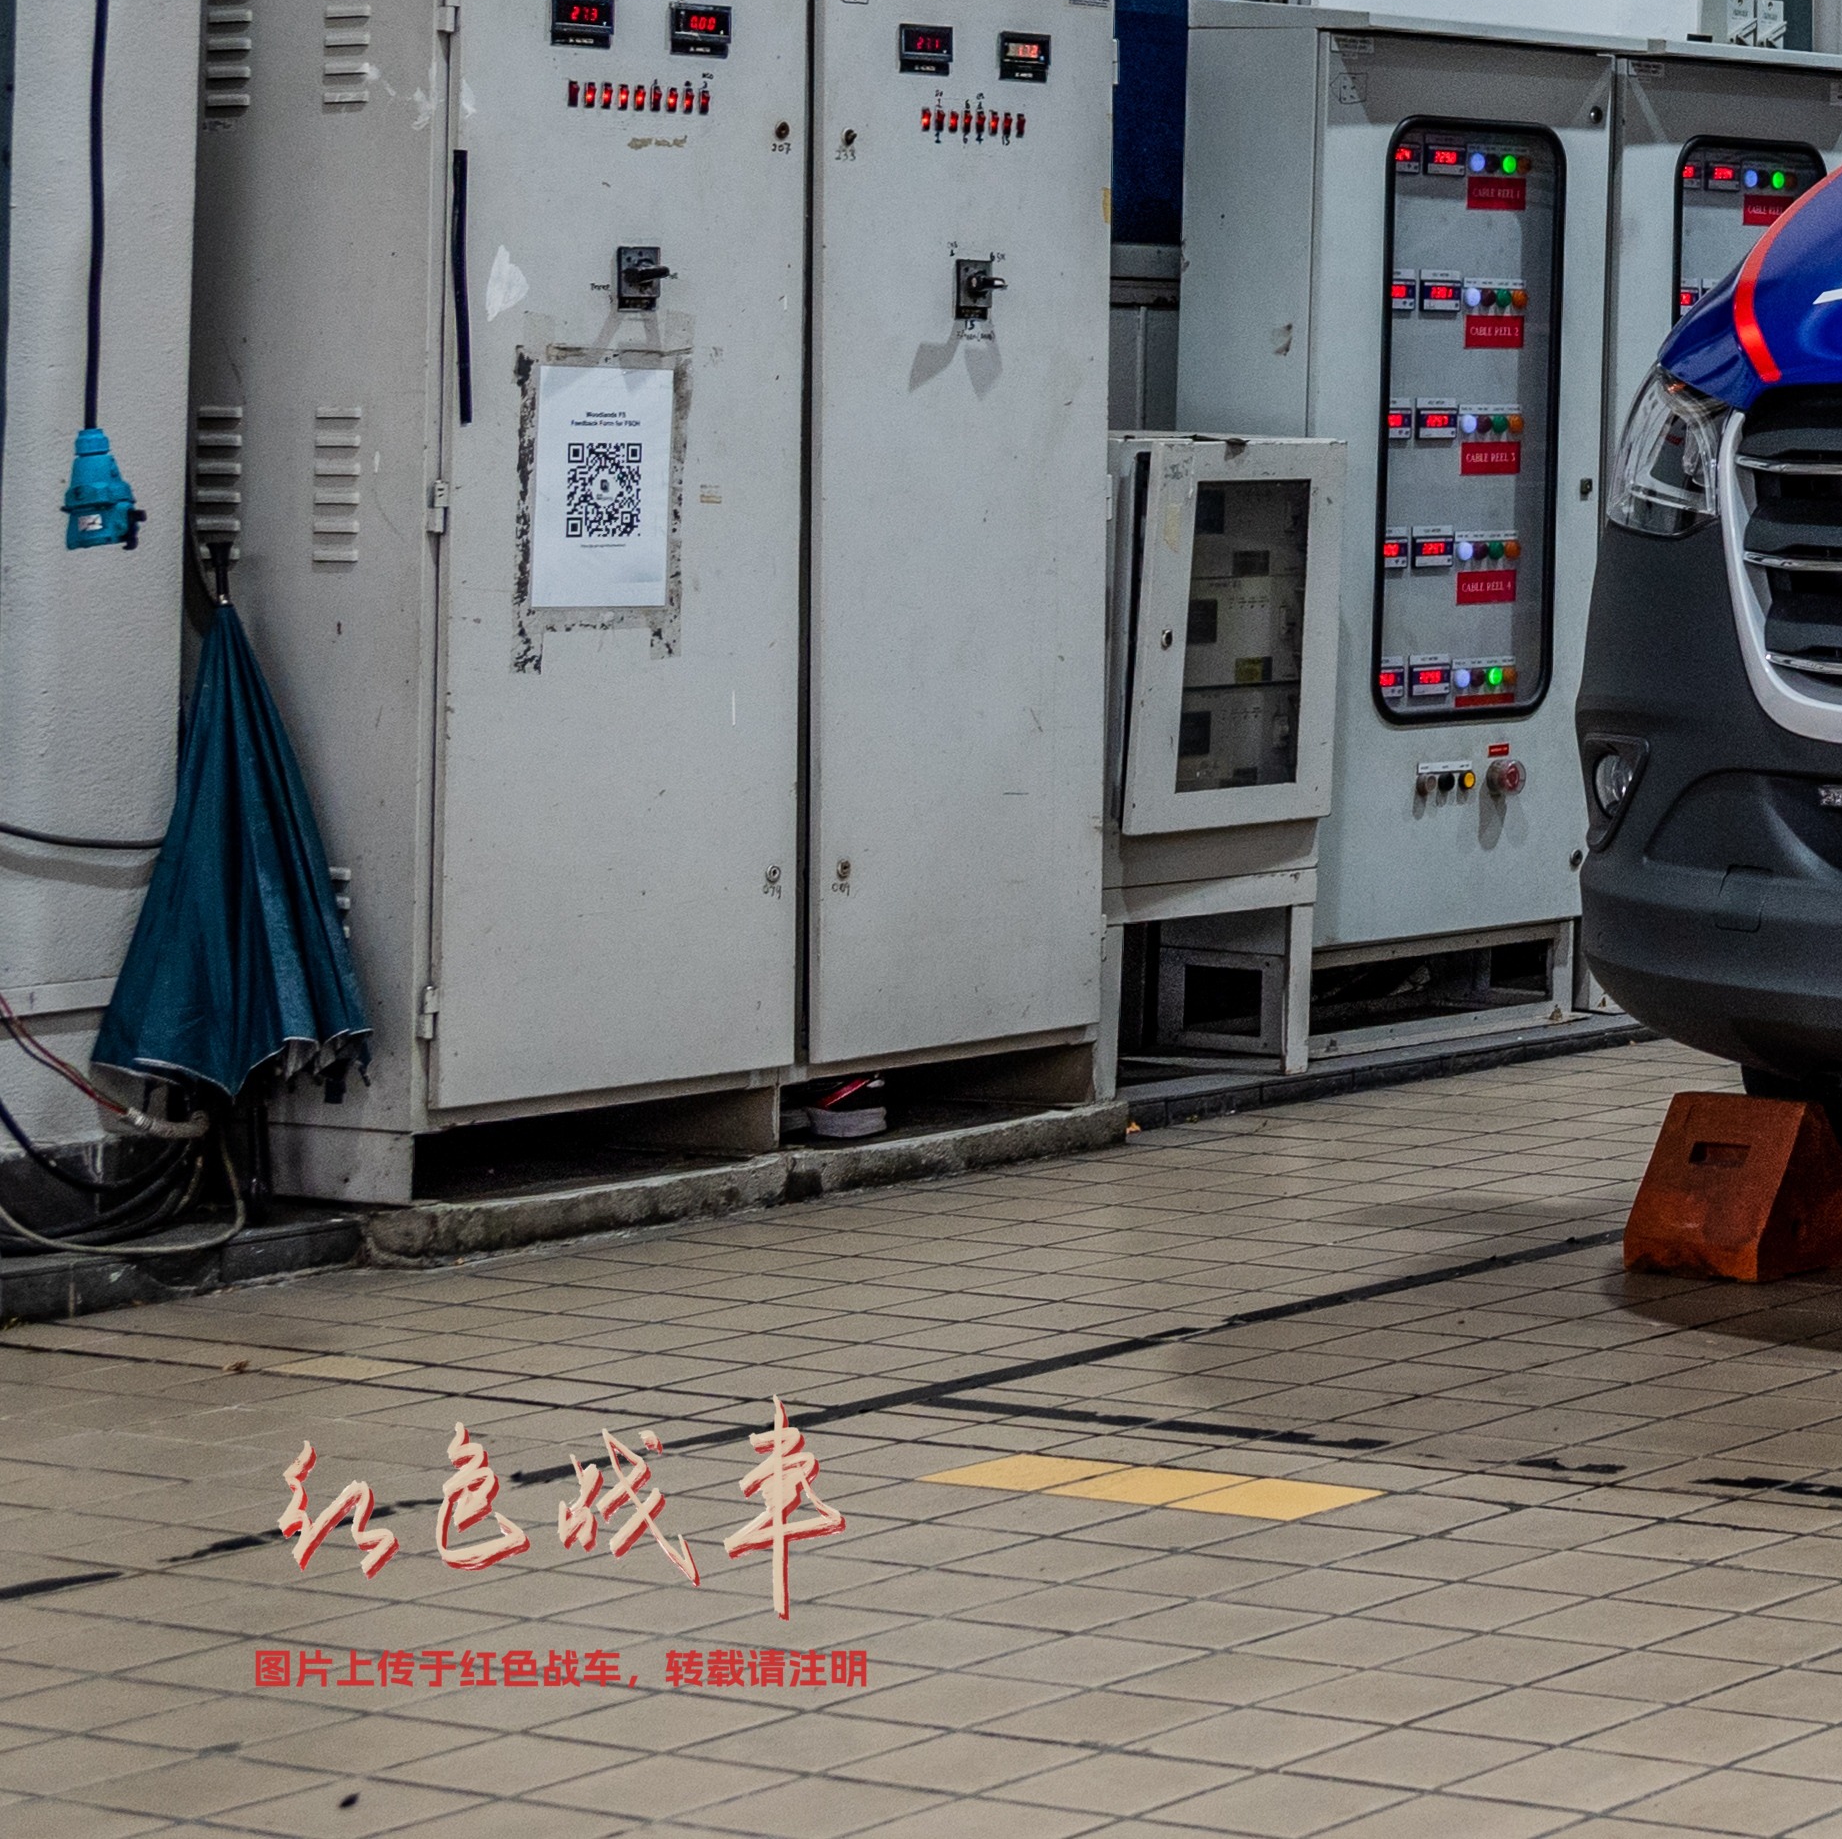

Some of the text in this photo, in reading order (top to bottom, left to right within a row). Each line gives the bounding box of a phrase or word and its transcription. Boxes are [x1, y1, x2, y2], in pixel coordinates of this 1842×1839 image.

[1470, 326, 1492, 336] CABLE
[1494, 326, 1512, 336] REEL
[1466, 452, 1488, 462] CABLE
[1490, 452, 1509, 462] REEL
[1461, 582, 1484, 592] CABLE
[1486, 581, 1504, 591] REEL
